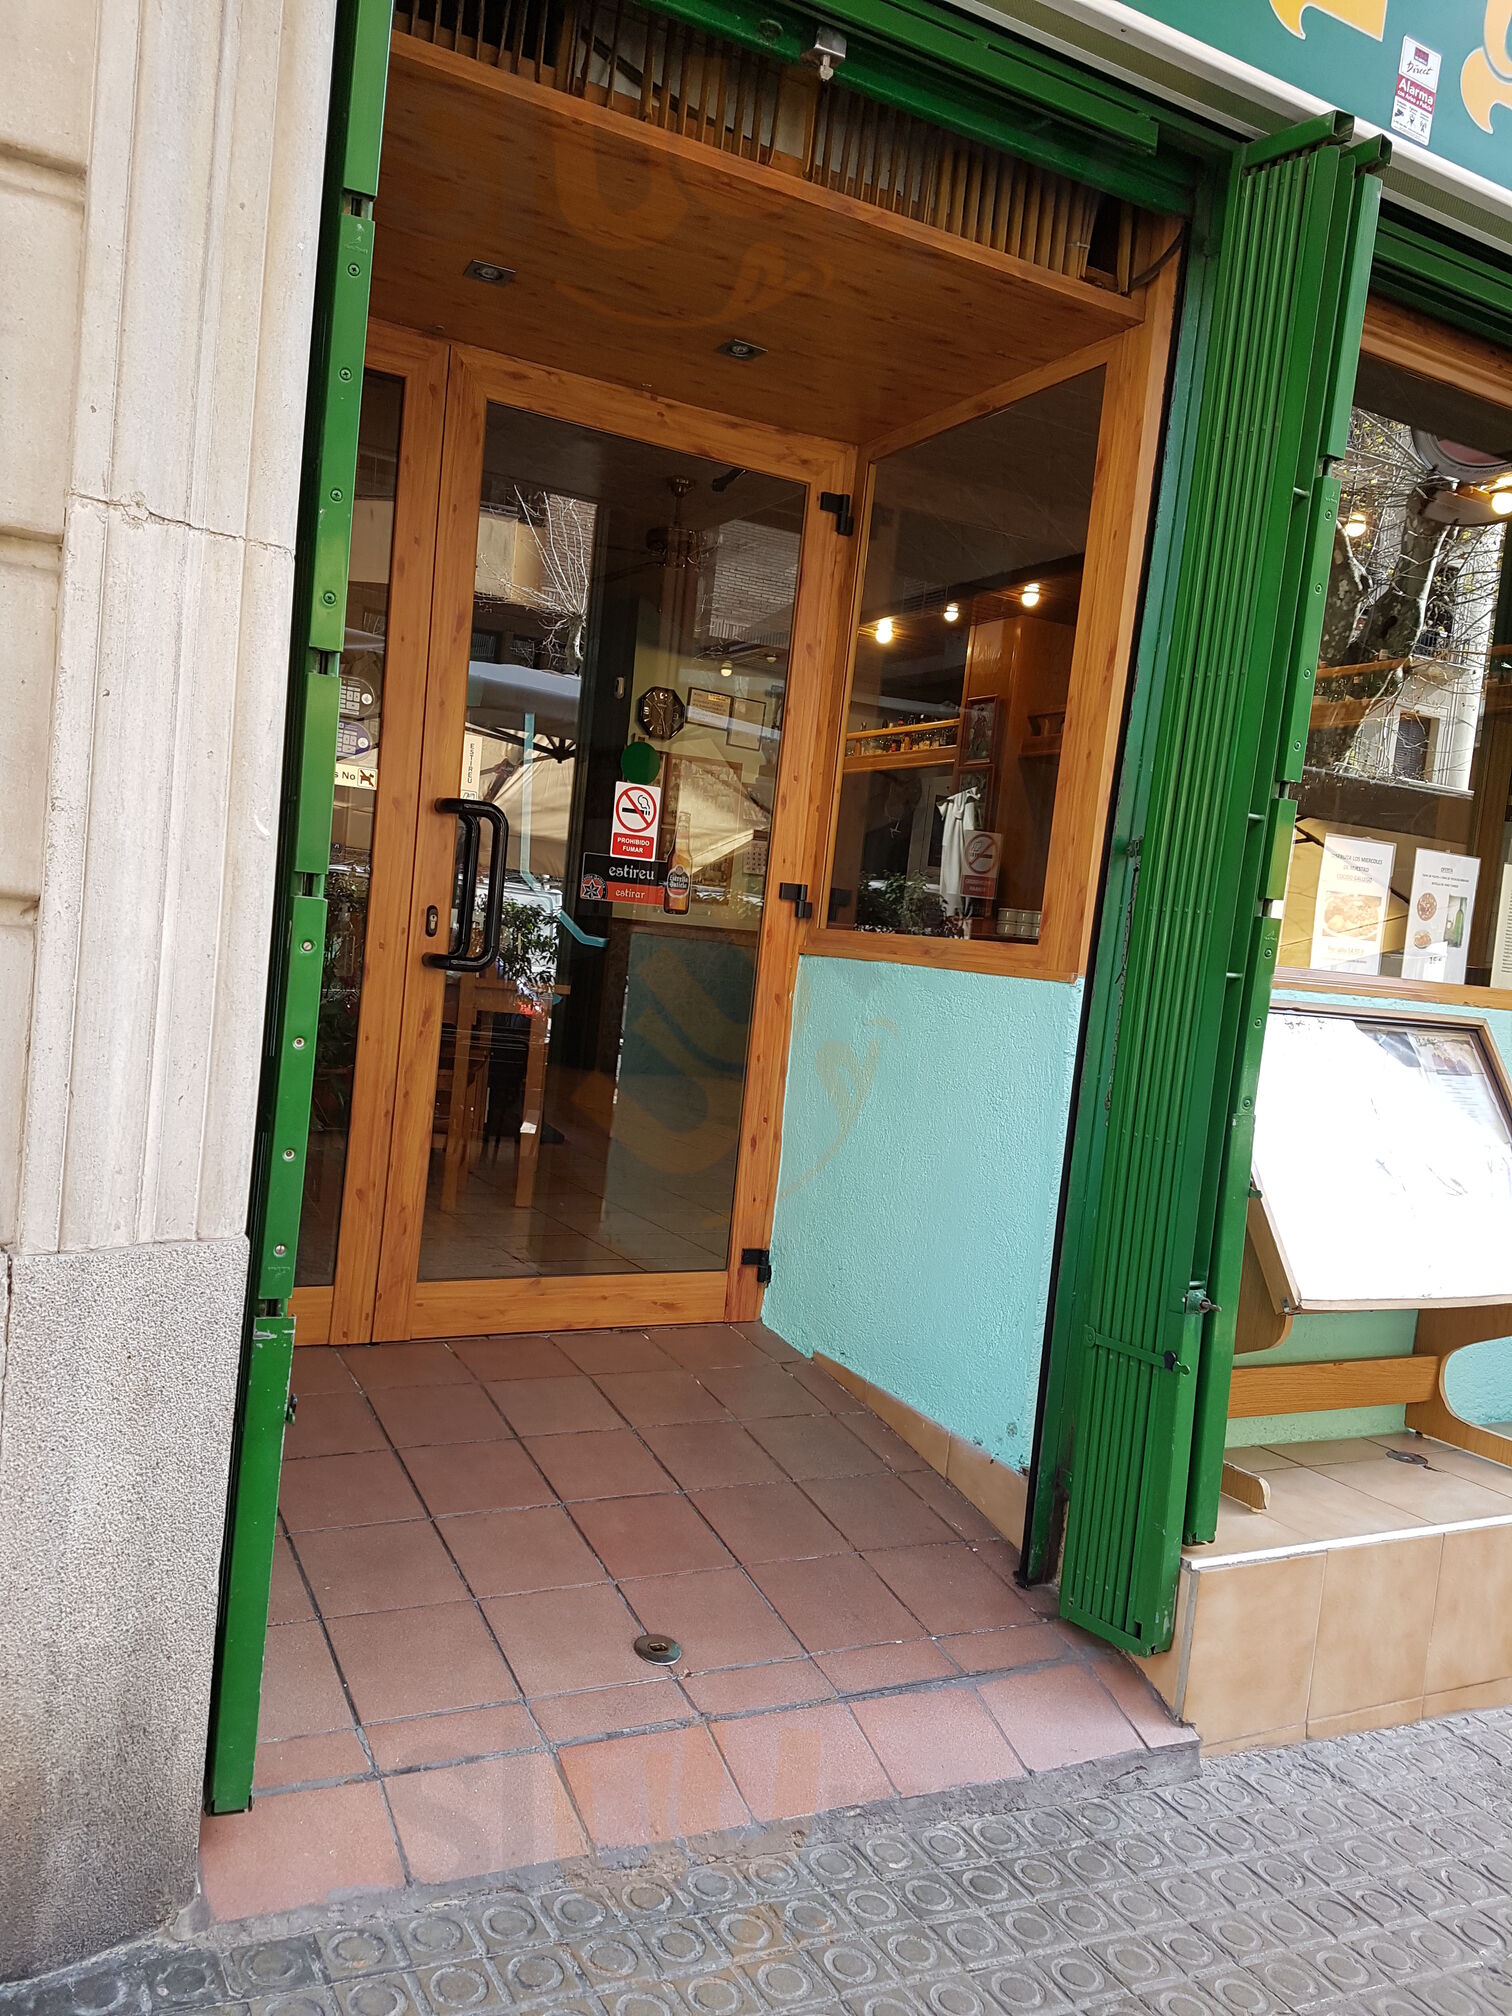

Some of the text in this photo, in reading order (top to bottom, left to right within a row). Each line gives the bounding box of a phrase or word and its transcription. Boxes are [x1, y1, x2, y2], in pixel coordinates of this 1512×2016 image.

[1398, 78, 1433, 105] Alarma
[342, 771, 356, 781] No
[617, 837, 650, 847] PROHIBIDO
[622, 845, 644, 854] FUMAR
[608, 864, 655, 880] estireu
[615, 888, 646, 899] estirar
